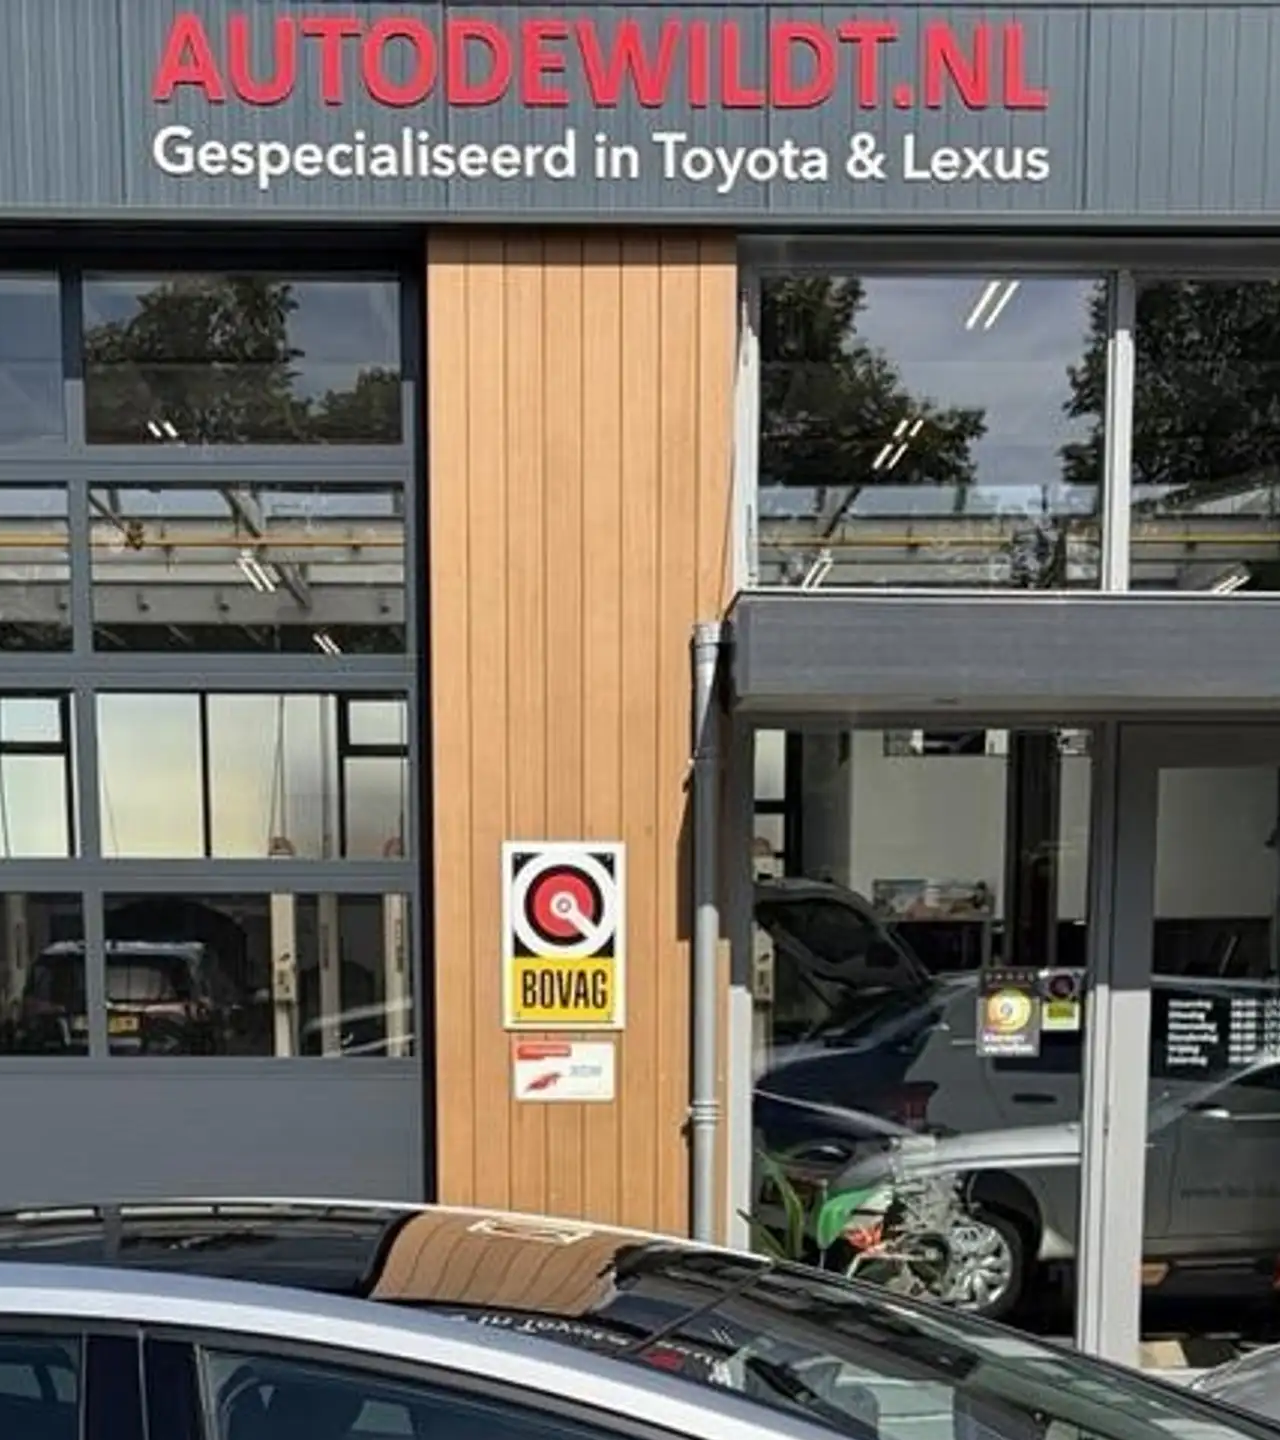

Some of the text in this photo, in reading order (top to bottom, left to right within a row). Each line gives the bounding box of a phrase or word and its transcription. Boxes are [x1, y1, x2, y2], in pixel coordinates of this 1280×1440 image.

[153, 13, 1048, 107] AUTODEWILDT.NL
[152, 124, 1050, 192] Gespecialiseerd in Toyota & Lexus
[521, 968, 608, 1009] BOVAG
